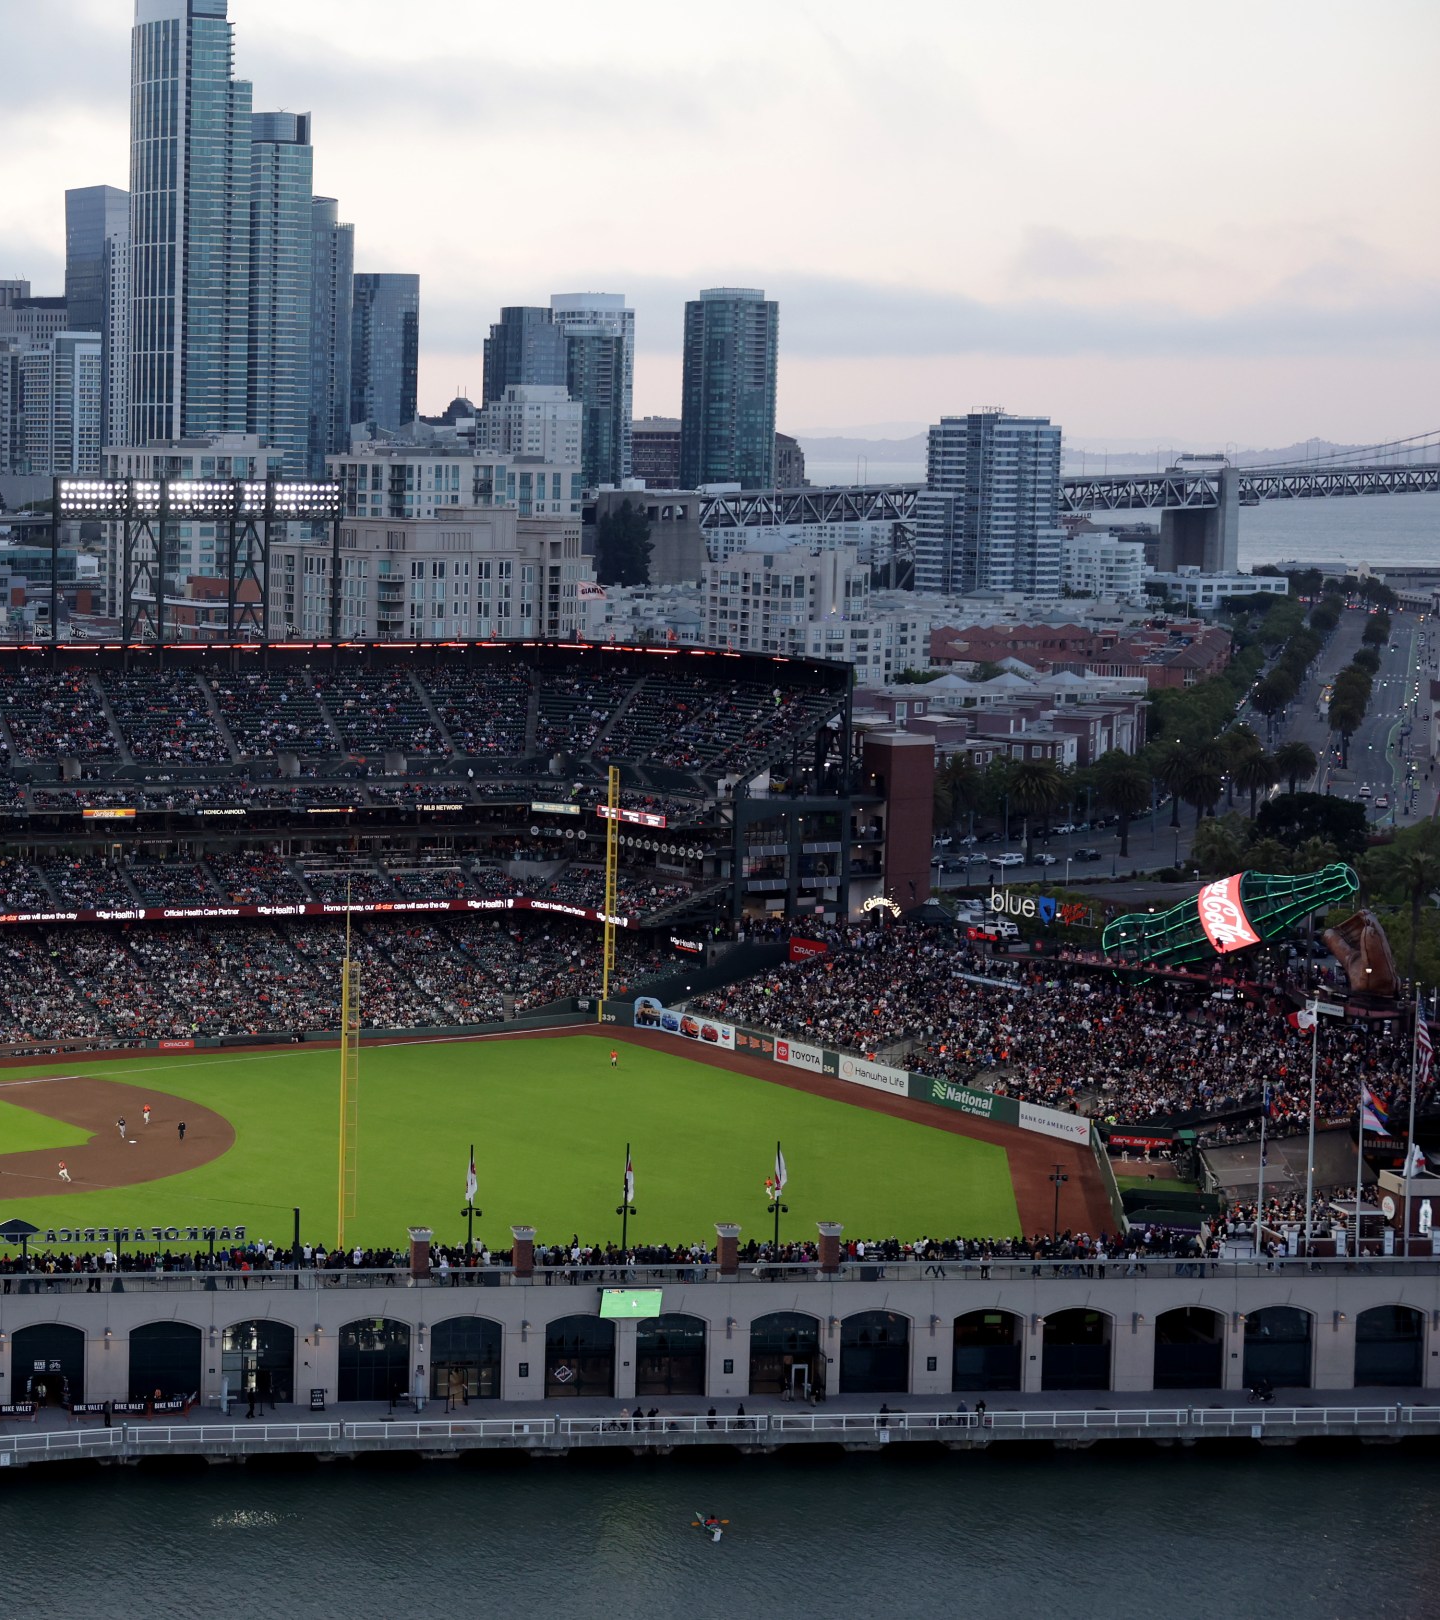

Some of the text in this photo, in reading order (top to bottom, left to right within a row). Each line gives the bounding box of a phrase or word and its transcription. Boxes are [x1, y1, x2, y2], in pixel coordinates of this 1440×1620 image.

[439, 902, 450, 910] day
[481, 899, 504, 907] Health
[991, 887, 1035, 918] blue
[111, 910, 134, 918] Health
[164, 909, 182, 917] Official
[204, 908, 218, 916] Care
[219, 907, 239, 915] Partner
[272, 905, 295, 913] Health
[66, 912, 77, 920] day
[680, 939, 696, 949] Health
[602, 1014, 616, 1022] 339
[791, 1049, 820, 1065] TOYOTA
[823, 1064, 835, 1073] 354
[855, 1066, 905, 1088] Hanwha Life
[946, 1087, 993, 1110] National
[961, 1105, 990, 1118] Car Rental
[1021, 1113, 1036, 1122] BANK
[1046, 1121, 1074, 1133] AMERICA
[1363, 1140, 1405, 1150] BOARDWALK
[114, 1403, 128, 1411] BIKE
[154, 1400, 183, 1410] BIKE VALET
